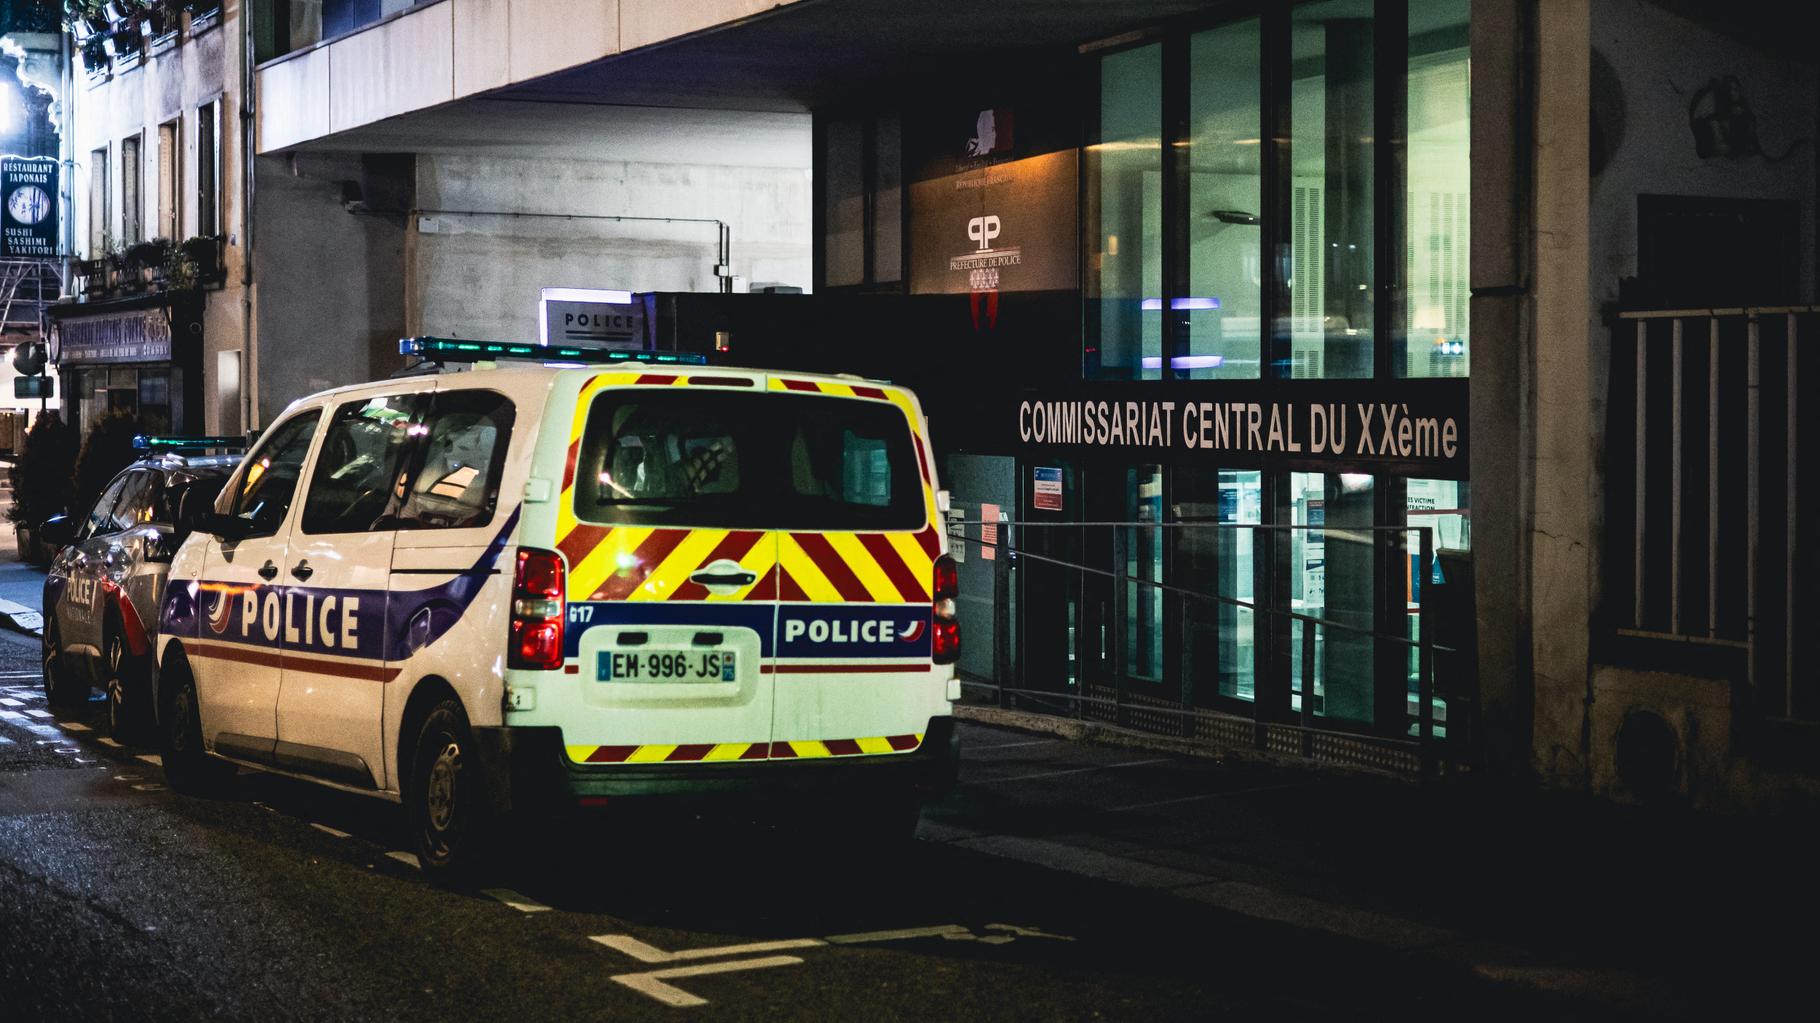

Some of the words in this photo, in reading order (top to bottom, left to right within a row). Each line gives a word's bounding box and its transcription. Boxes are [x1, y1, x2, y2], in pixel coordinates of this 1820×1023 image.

[3, 162, 54, 174] RESTAURANT
[9, 173, 48, 183] JAPONAIS
[5, 228, 33, 237] SUSHI
[7, 237, 47, 246] SASHIMI
[8, 246, 54, 255] YAKITORI
[988, 257, 998, 267] DE
[998, 255, 1021, 266] POLICE
[565, 312, 633, 329] POLICE
[1019, 400, 1175, 446] COMMISSARIAT
[1183, 402, 1301, 452] CENTRAL
[1310, 403, 1347, 455] DU
[67, 575, 91, 605] POLICE
[241, 590, 360, 649] POLICE
[784, 619, 895, 643] POLICE
[612, 652, 720, 679] EM-996-JS
